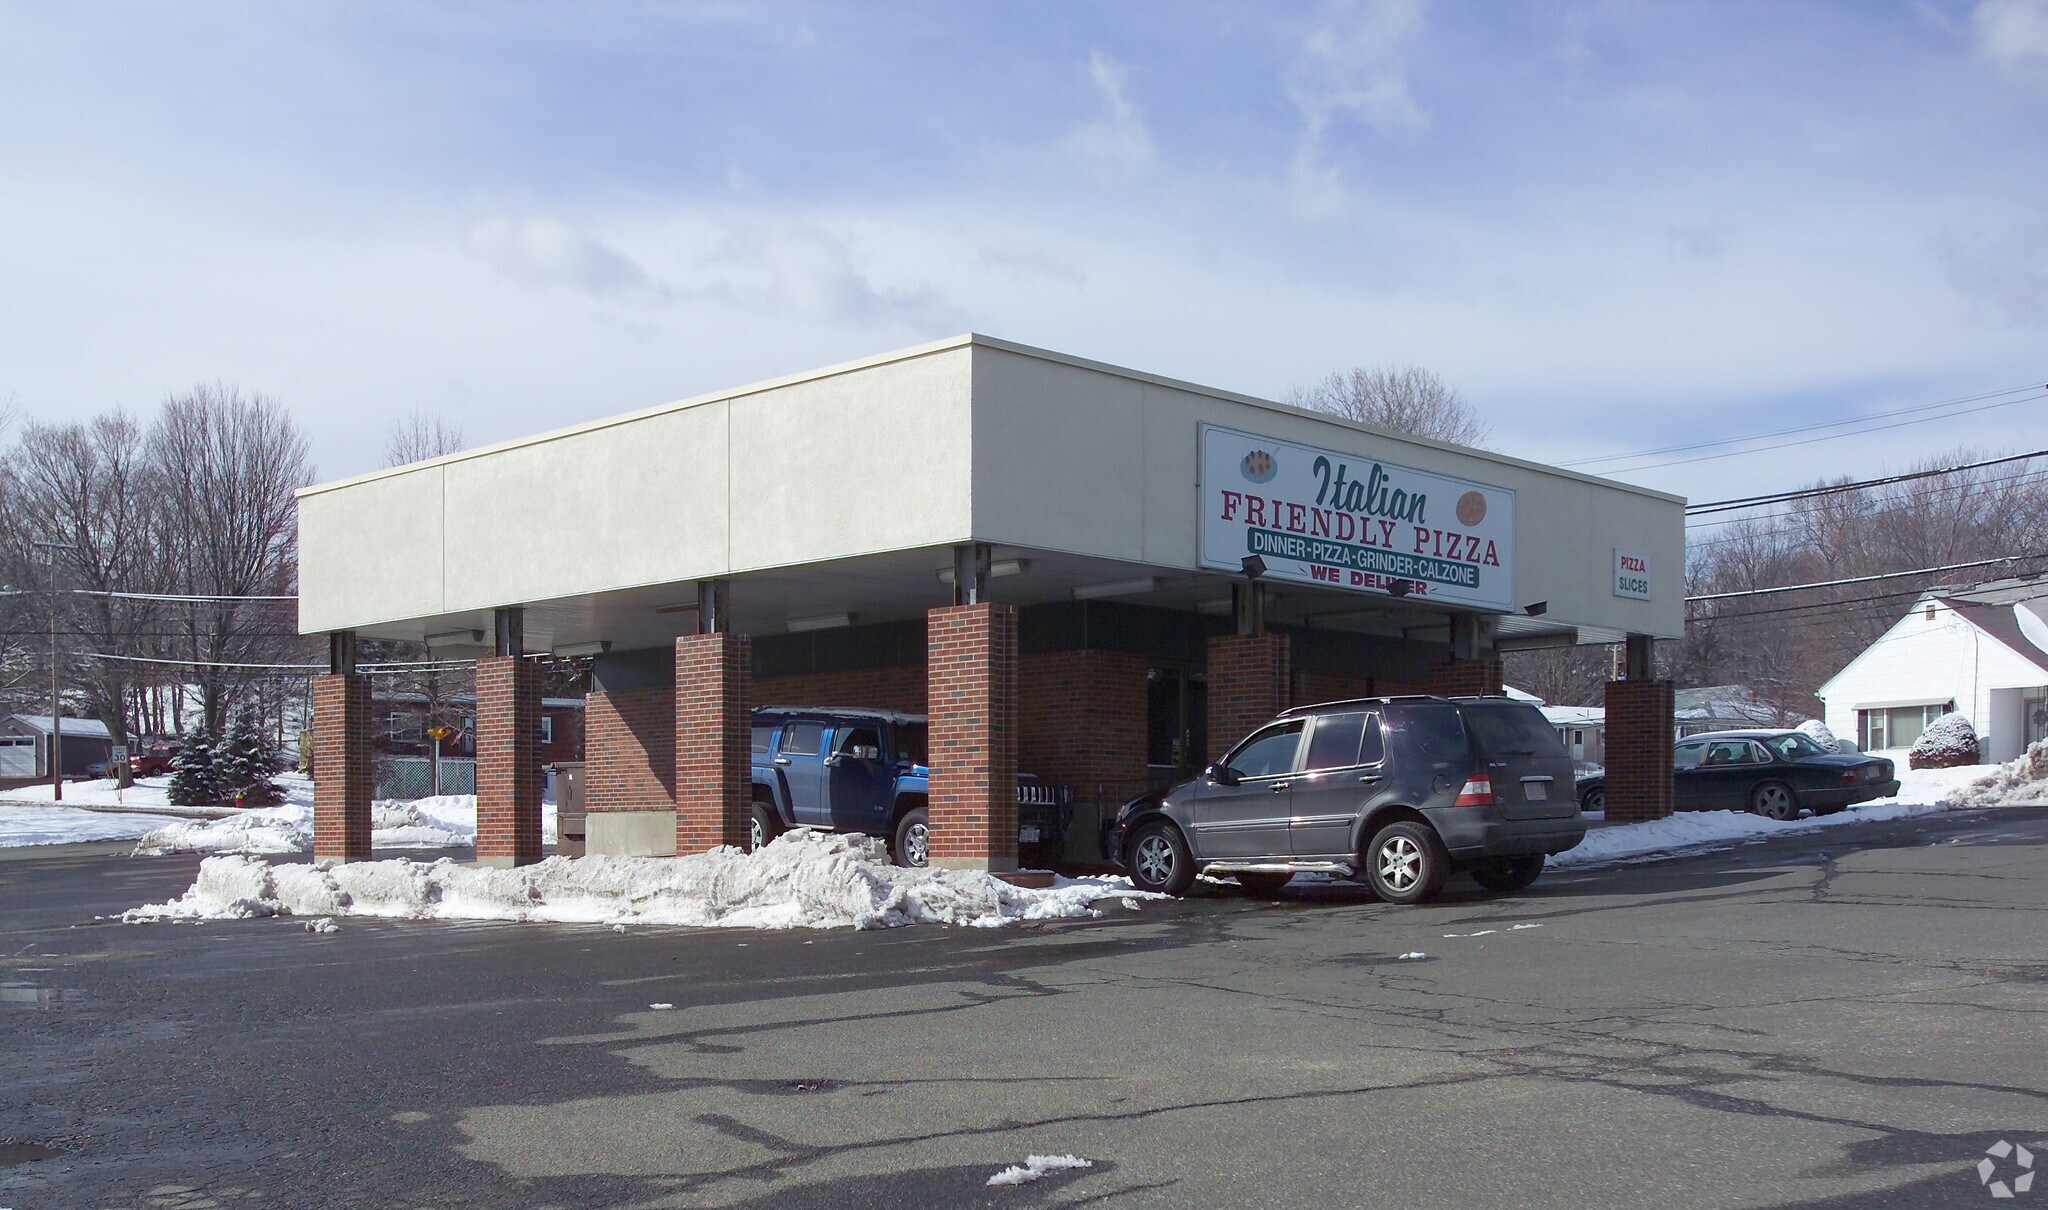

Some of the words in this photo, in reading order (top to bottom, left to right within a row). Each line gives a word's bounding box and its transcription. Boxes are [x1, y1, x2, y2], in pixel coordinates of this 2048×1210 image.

[1313, 455, 1426, 524] Italian
[1221, 489, 1396, 549] FRIENDLY
[1413, 525, 1500, 567] PIZZA
[1310, 564, 1340, 583] WE
[1621, 556, 1646, 573] PIZZA
[1619, 576, 1648, 594] SLICES
[114, 754, 126, 762] 30
